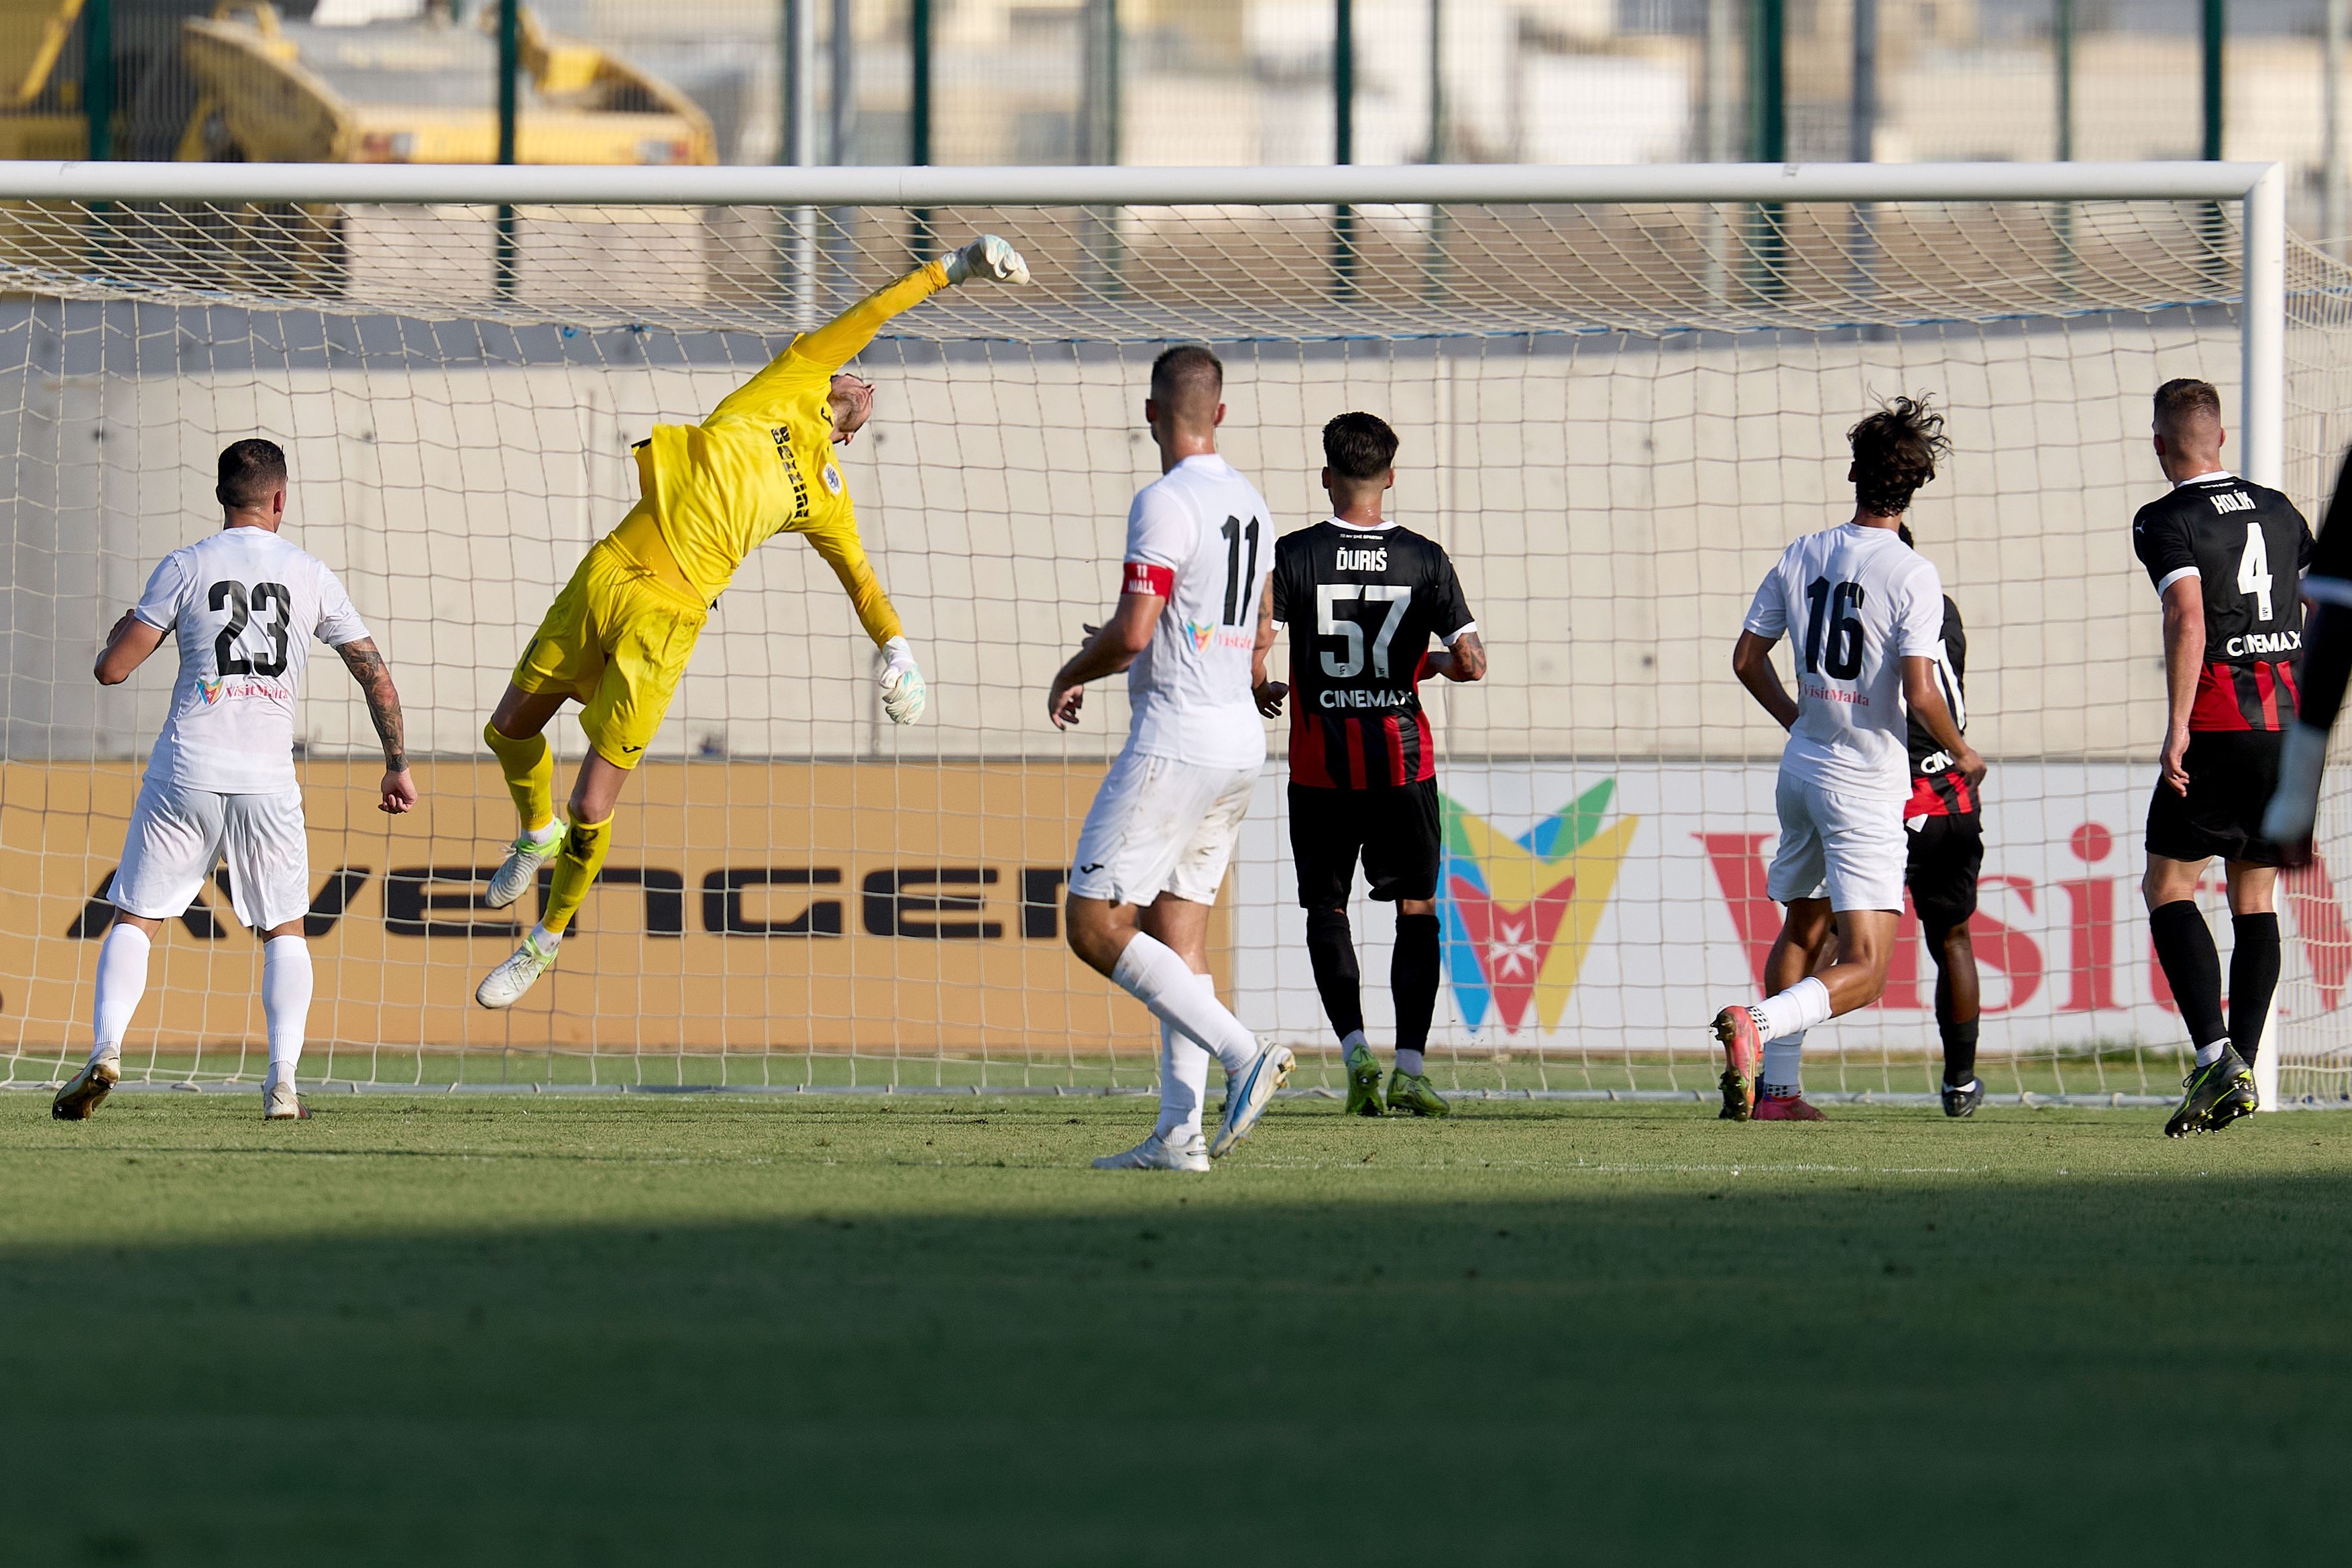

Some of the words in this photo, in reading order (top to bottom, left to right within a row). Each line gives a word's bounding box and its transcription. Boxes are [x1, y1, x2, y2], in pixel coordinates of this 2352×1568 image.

[1221, 515, 1259, 626] 11
[1336, 547, 1388, 571] ĎURIŠ
[2237, 521, 2273, 621] 4
[208, 580, 291, 677] 23
[1317, 584, 1412, 679] 57
[1805, 575, 1864, 681] 16
[2226, 630, 2302, 657] CINEMAX
[1319, 689, 1413, 708] CINEMAX
[1803, 683, 1870, 707] VisitMalta
[66, 865, 1073, 938] AVENGE
